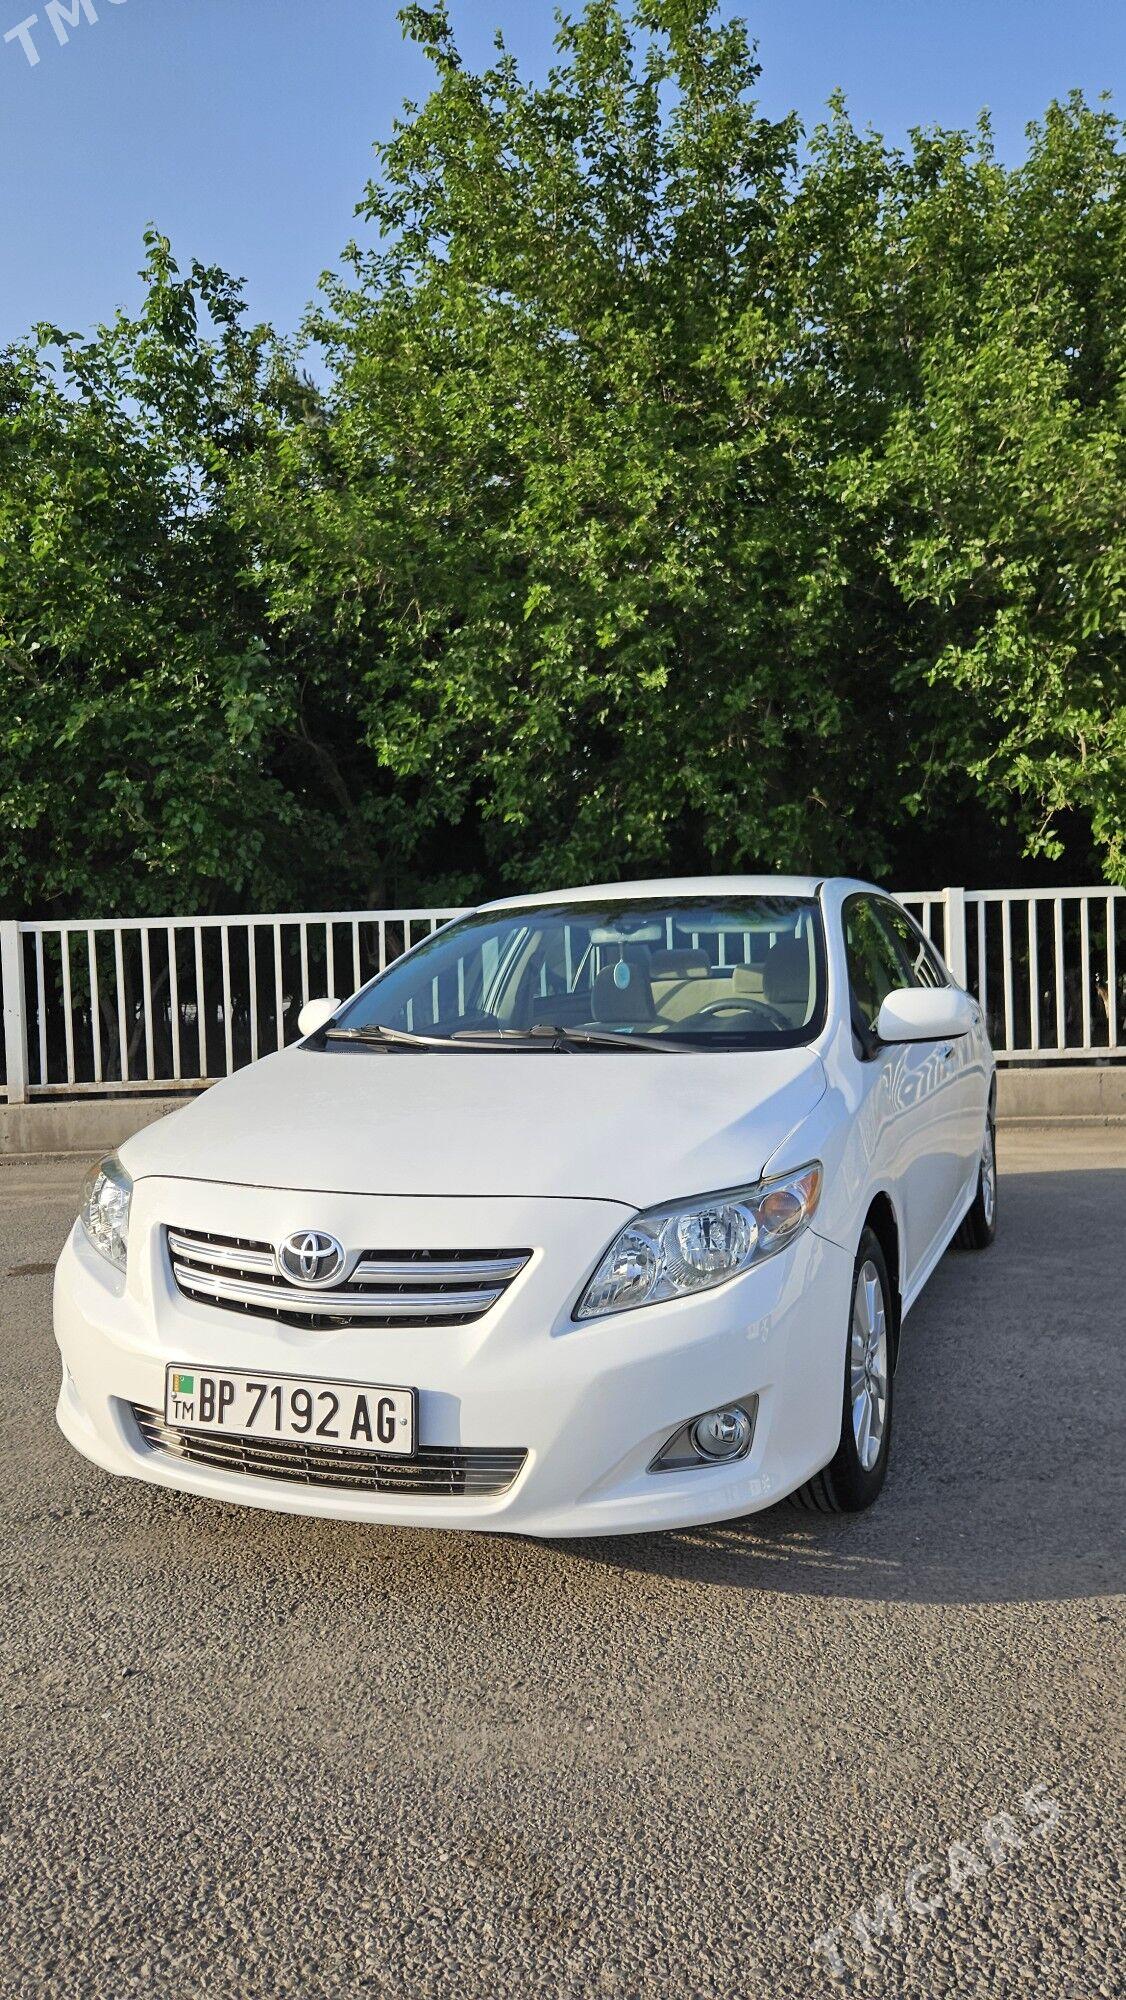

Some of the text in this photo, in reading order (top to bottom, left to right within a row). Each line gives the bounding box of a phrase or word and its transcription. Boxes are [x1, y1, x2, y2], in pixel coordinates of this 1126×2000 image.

[172, 1400, 194, 1421] TM
[199, 1377, 396, 1444] BP 7192 AG
